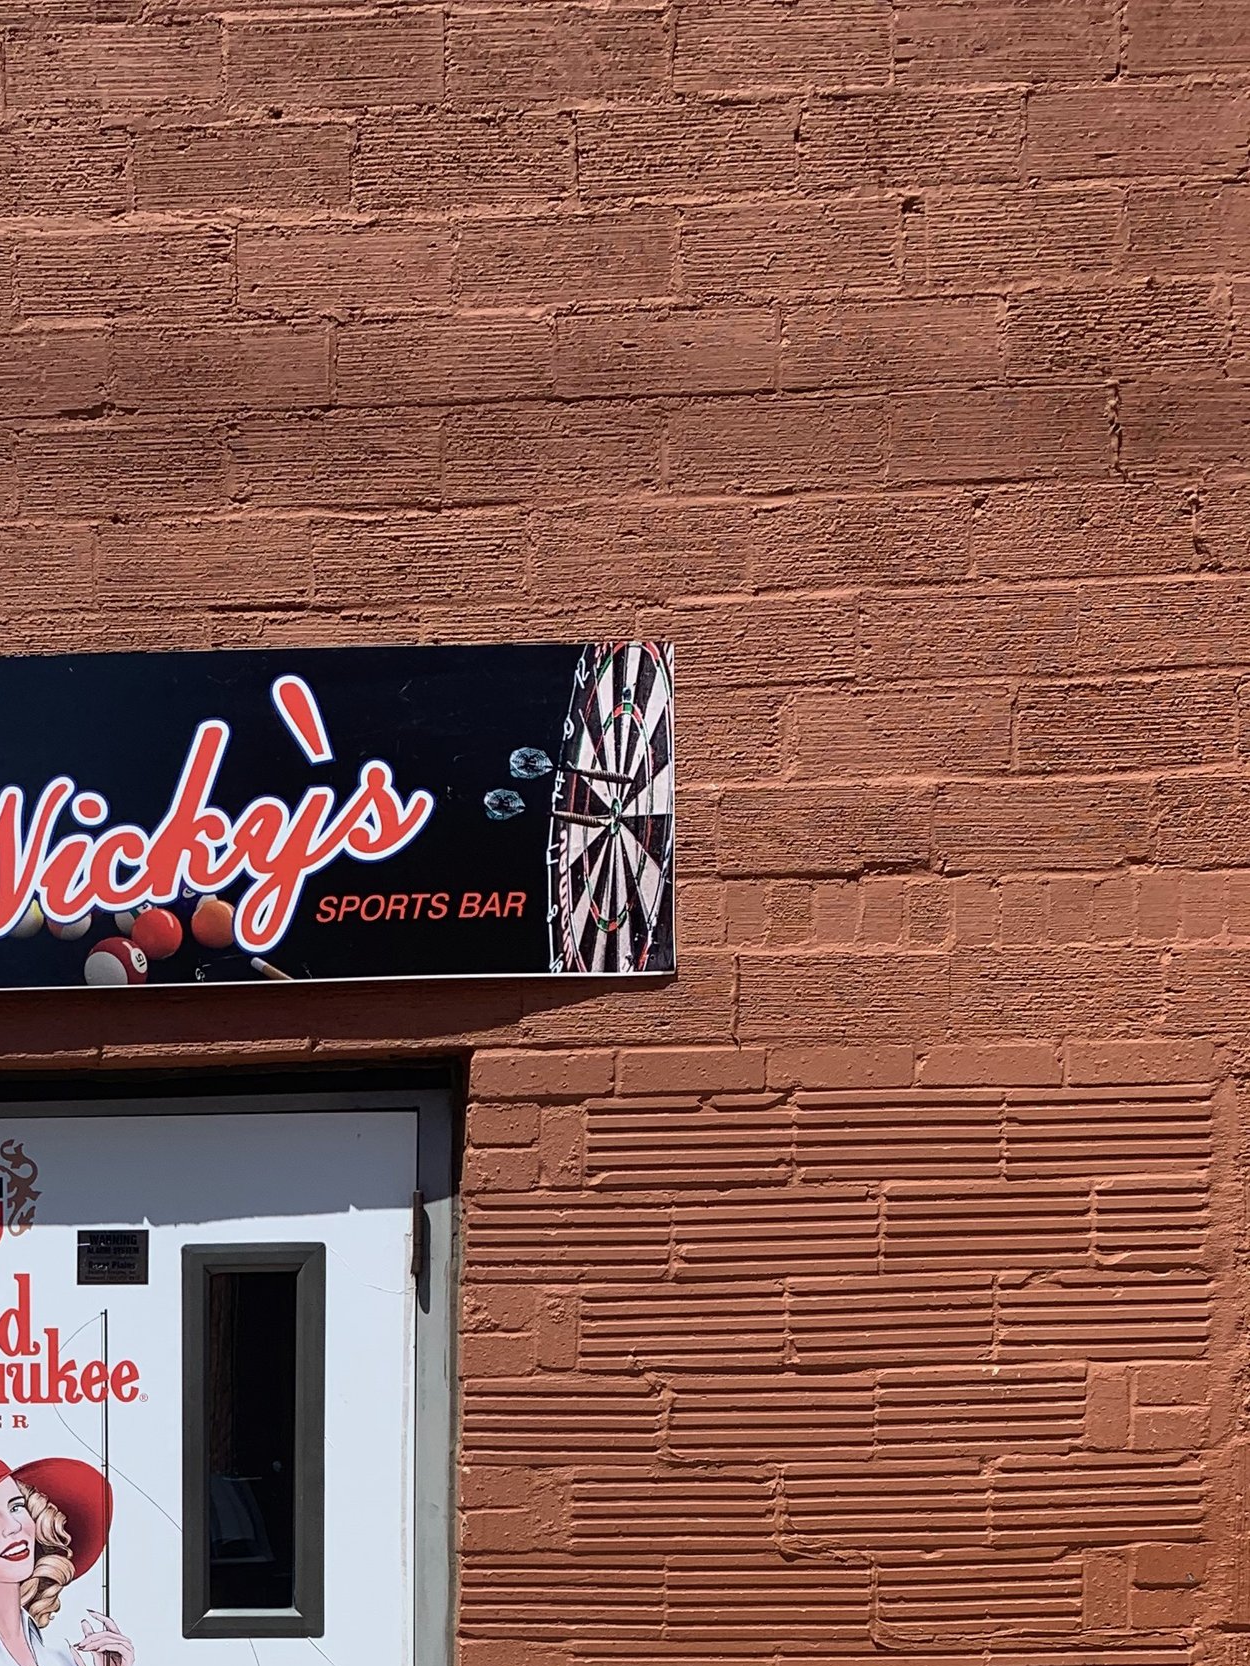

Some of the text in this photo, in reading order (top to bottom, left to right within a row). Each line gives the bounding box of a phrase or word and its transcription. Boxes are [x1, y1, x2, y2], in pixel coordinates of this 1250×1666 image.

[315, 891, 527, 923] SPORTS BAR
[89, 1234, 138, 1246] WARNING
